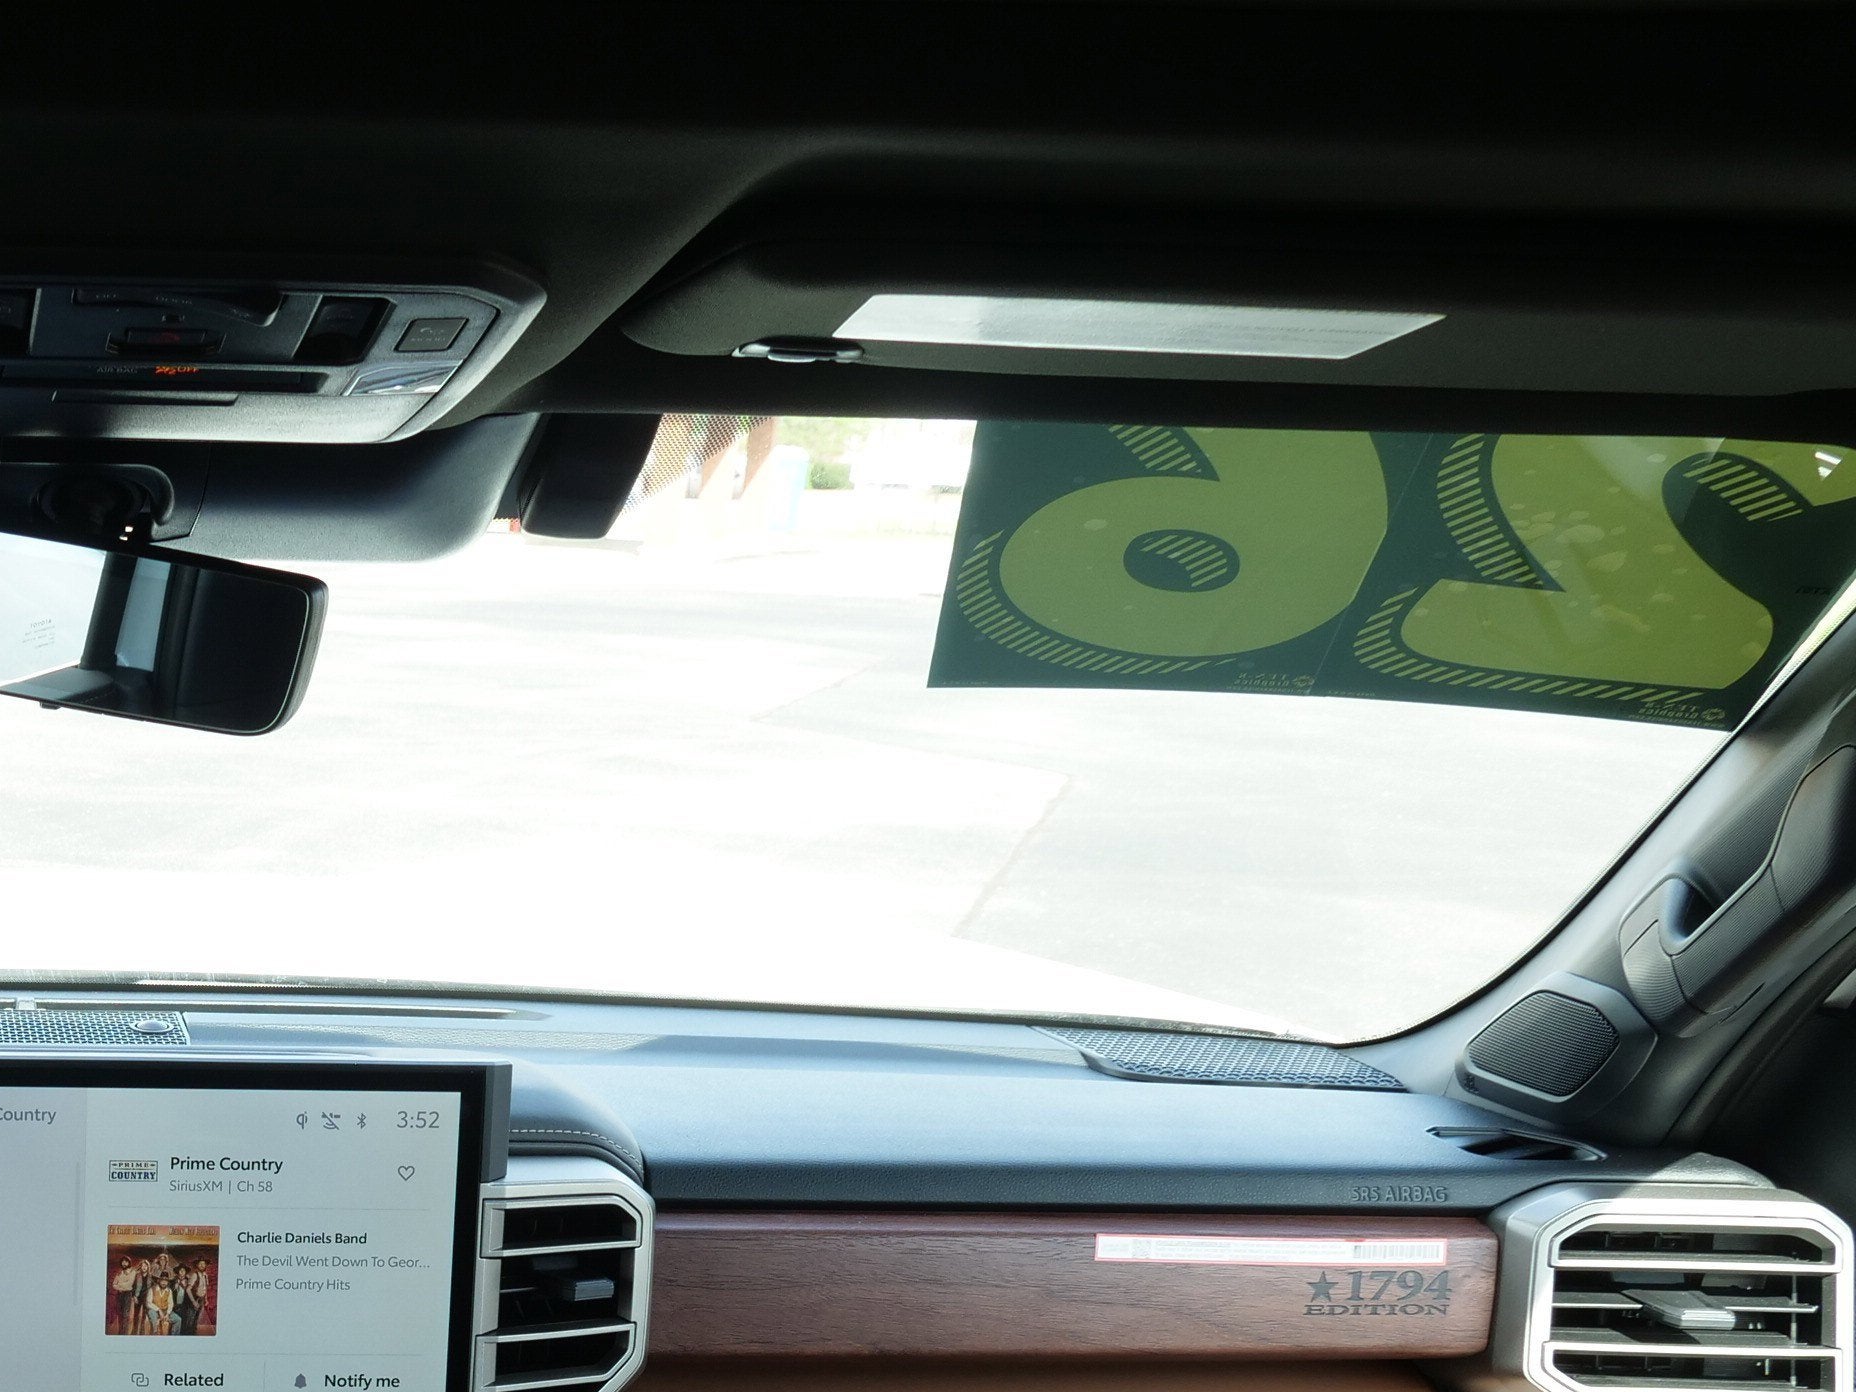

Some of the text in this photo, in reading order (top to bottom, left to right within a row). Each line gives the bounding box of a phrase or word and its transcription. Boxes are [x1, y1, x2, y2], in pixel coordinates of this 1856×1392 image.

[396, 1110, 440, 1129] 3:52
[170, 1156, 283, 1174] Prime Country
[111, 1170, 156, 1180] COUNTRY
[169, 1180, 273, 1193] SiriusXM Ch 58
[1352, 1186, 1448, 1202] SRS AIRBAG
[237, 1232, 367, 1244] Charlie Daniels Band
[237, 1255, 259, 1267] The
[262, 1255, 293, 1268] Devil
[295, 1255, 329, 1268] Went
[332, 1256, 368, 1268] Down
[371, 1256, 386, 1268] To
[236, 1278, 351, 1293] Prime Country Hits
[1347, 1270, 1451, 1301] 1794
[1304, 1304, 1450, 1316] EDITION
[165, 1373, 400, 1390] Related Notify me
